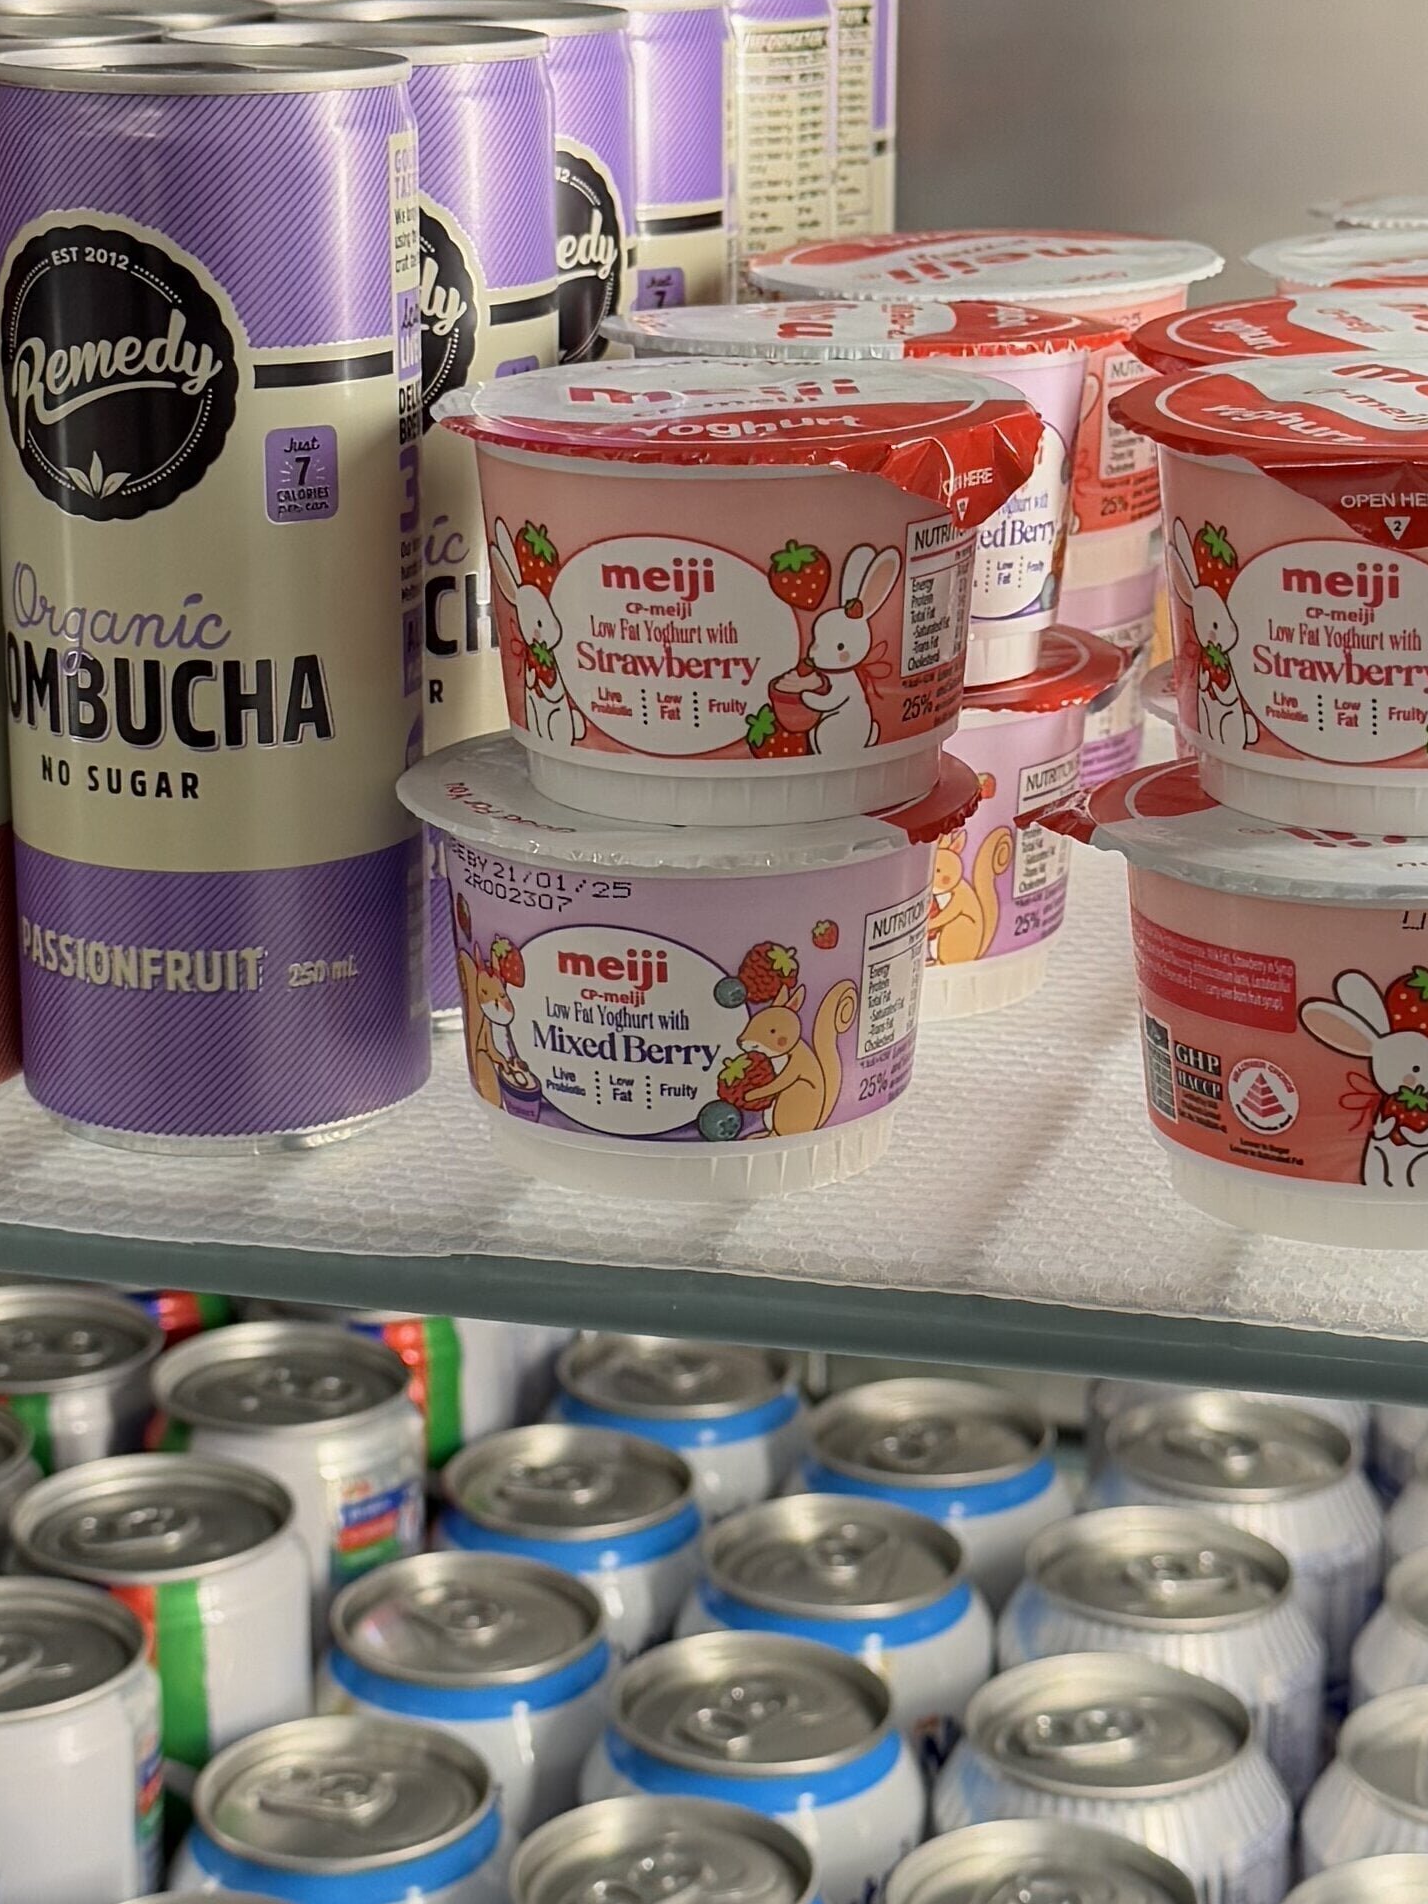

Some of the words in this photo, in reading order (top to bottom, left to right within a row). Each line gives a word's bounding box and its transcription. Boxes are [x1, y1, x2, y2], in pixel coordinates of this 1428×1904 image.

[50, 246, 79, 268] EST
[84, 246, 131, 271] 2012
[11, 307, 224, 450] Remedy
[283, 435, 321, 454] Just
[295, 455, 312, 486] 7
[275, 485, 330, 503] CALORIES
[1340, 493, 1396, 509] OPEN
[1010, 519, 1056, 546] Berry
[601, 557, 715, 603] meiji
[1282, 561, 1400, 608] meiji
[10, 560, 232, 677] Organic
[625, 602, 692, 620] CP-meiji
[1305, 607, 1376, 625] CP-meiji
[590, 615, 618, 639] Low
[620, 619, 642, 641] Fat
[644, 619, 703, 650] Yoghurt
[705, 620, 739, 645] with
[1268, 619, 1296, 643] Low
[1298, 623, 1321, 646] Fat
[1323, 623, 1385, 654] Yoghurt
[1388, 626, 1422, 652] with
[576, 640, 762, 686] Strawberry
[597, 687, 623, 703] Live
[656, 692, 683, 706] Low
[708, 698, 748, 717] Fruity
[901, 689, 934, 723] 25%
[1273, 691, 1299, 708] Live
[1334, 698, 1361, 713] Low
[659, 705, 682, 722] Fat
[1337, 711, 1359, 729] Fat
[1387, 705, 1428, 725] Fruity
[40, 754, 71, 787] NO
[87, 765, 201, 800] SUGAR
[464, 867, 573, 913] 2R002307
[19, 915, 268, 993] PASSIONFRUIT
[557, 946, 669, 990] meiji
[580, 987, 646, 1007] CP-meiji
[545, 999, 571, 1021] Low
[574, 1002, 594, 1024] Fat
[593, 1003, 654, 1032] Yoghurt
[657, 1008, 690, 1032] with
[531, 1019, 624, 1062] Mixed
[629, 1034, 722, 1071] Berry
[1175, 1043, 1220, 1075] GHP
[551, 1067, 577, 1083] Live
[608, 1074, 635, 1089] Low
[858, 1070, 889, 1102] 25%
[1178, 1072, 1222, 1099] HACCP
[611, 1087, 634, 1103] Fat
[659, 1083, 699, 1101] Fruity
